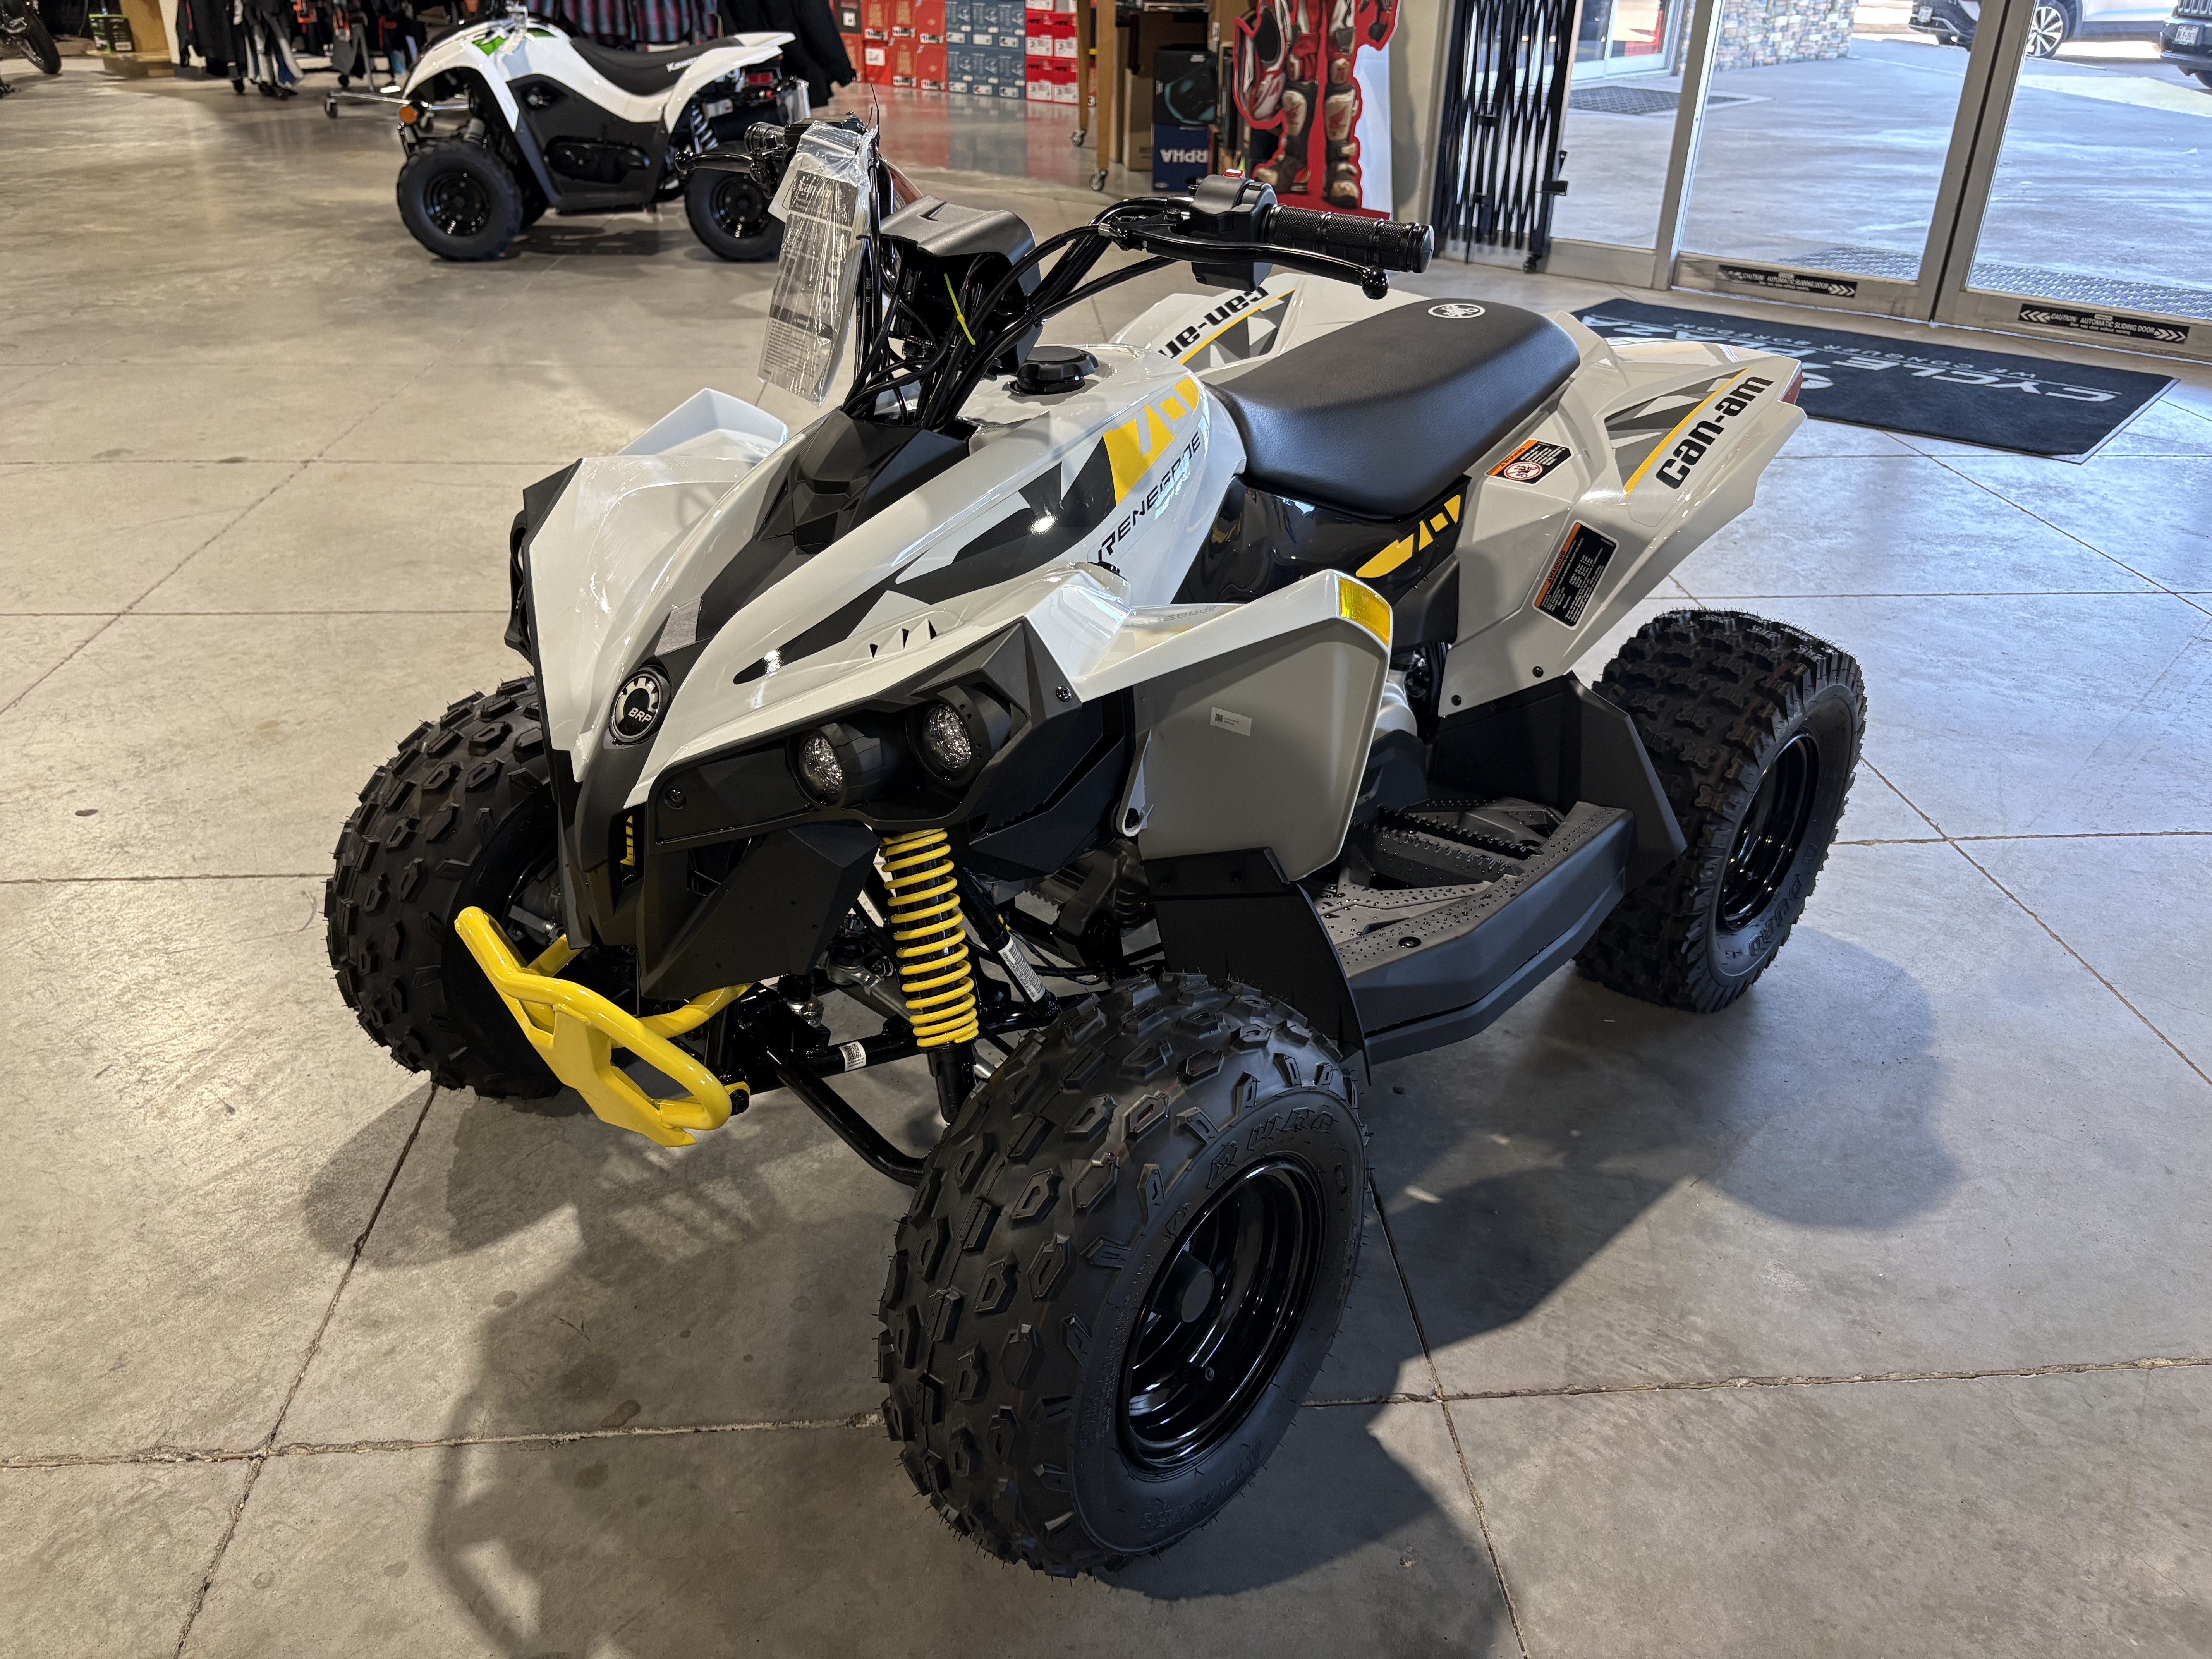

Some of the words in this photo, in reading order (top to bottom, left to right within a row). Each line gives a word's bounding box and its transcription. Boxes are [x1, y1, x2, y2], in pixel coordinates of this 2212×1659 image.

[1766, 275, 1795, 285] AUTOMATIC
[1795, 279, 1814, 288] SLIDING
[1672, 323, 1812, 346] BOREDOM
[2051, 313, 2078, 323] CAUTION:
[2080, 317, 2114, 328] AUTOMATIC
[2114, 322, 2136, 331] SLIDING
[2137, 325, 2155, 334] DOOR
[1823, 344, 1974, 369] CONQUER
[1832, 356, 2116, 402] CYCLE
[1988, 368, 2036, 378] WE
[1656, 376, 1774, 489] can-am
[1504, 447, 1525, 464] WARNING
[1098, 431, 1201, 562] RENEGADE
[1549, 550, 1566, 579] WARNING
[628, 707, 652, 723] BRP
[1748, 873, 1803, 956] DURO
